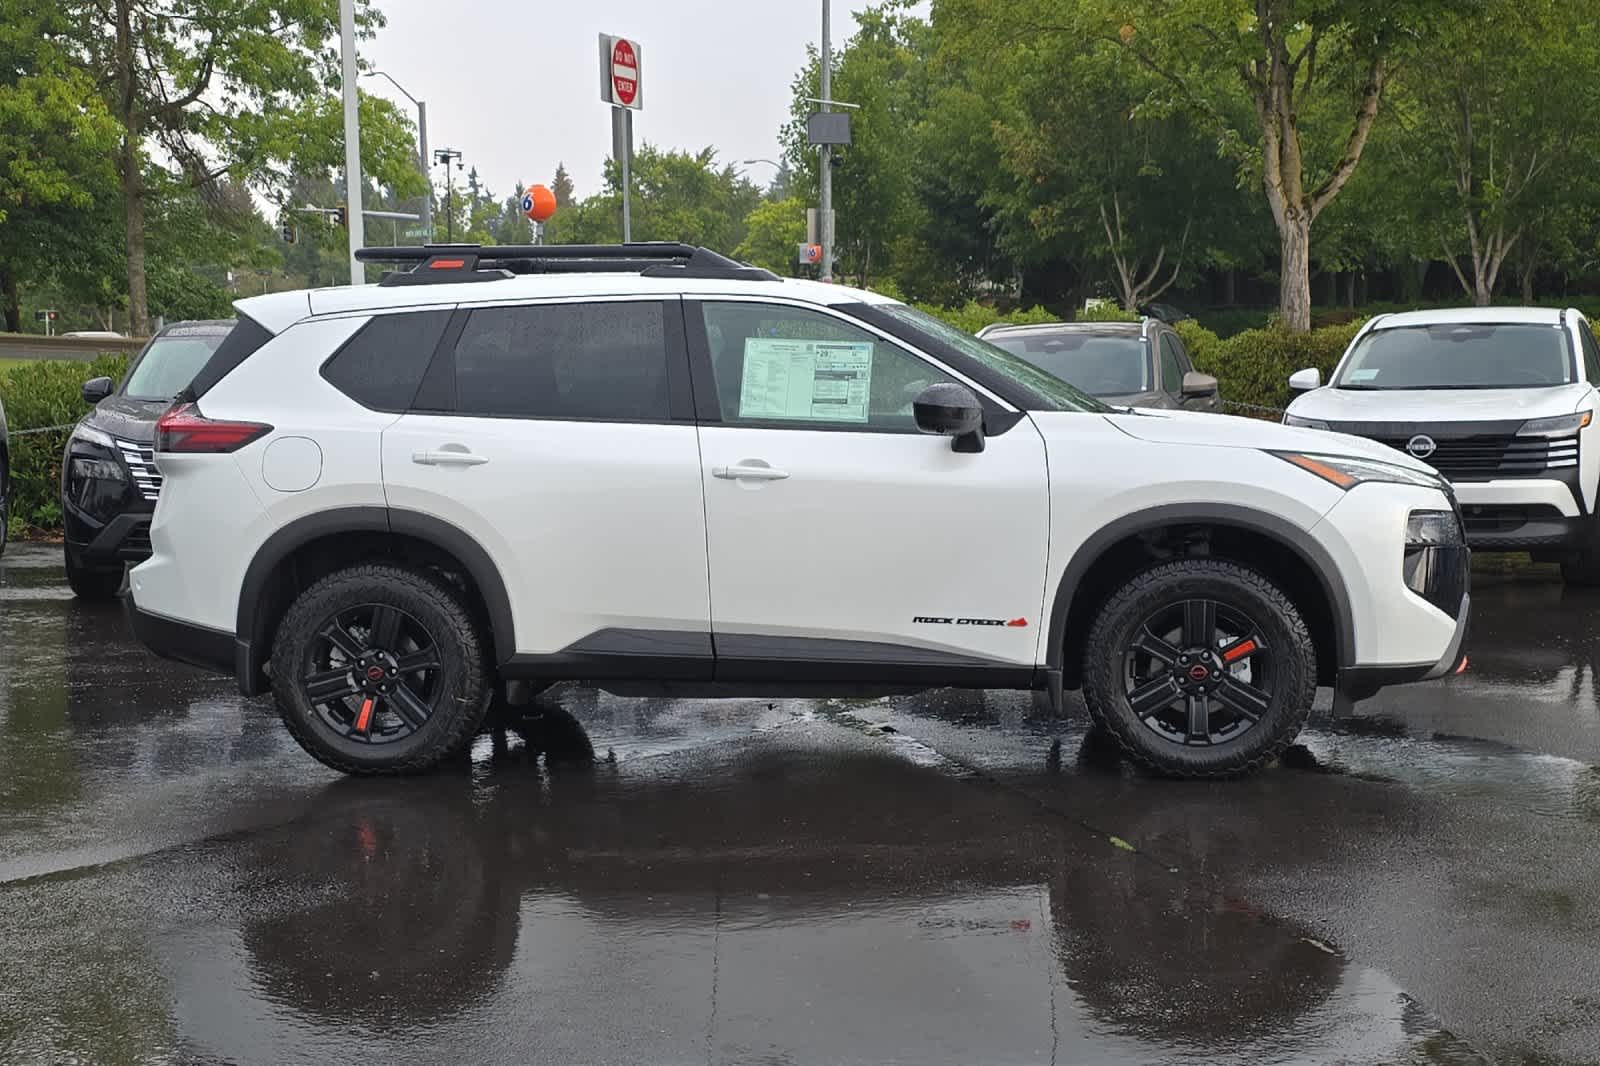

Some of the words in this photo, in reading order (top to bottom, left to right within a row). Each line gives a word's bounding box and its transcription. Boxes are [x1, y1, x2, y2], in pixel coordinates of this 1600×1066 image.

[615, 49, 623, 62] DO
[623, 52, 634, 65] NOT
[617, 80, 633, 93] ENTER
[913, 616, 953, 624] ROCK
[956, 617, 1006, 626] CREEK
